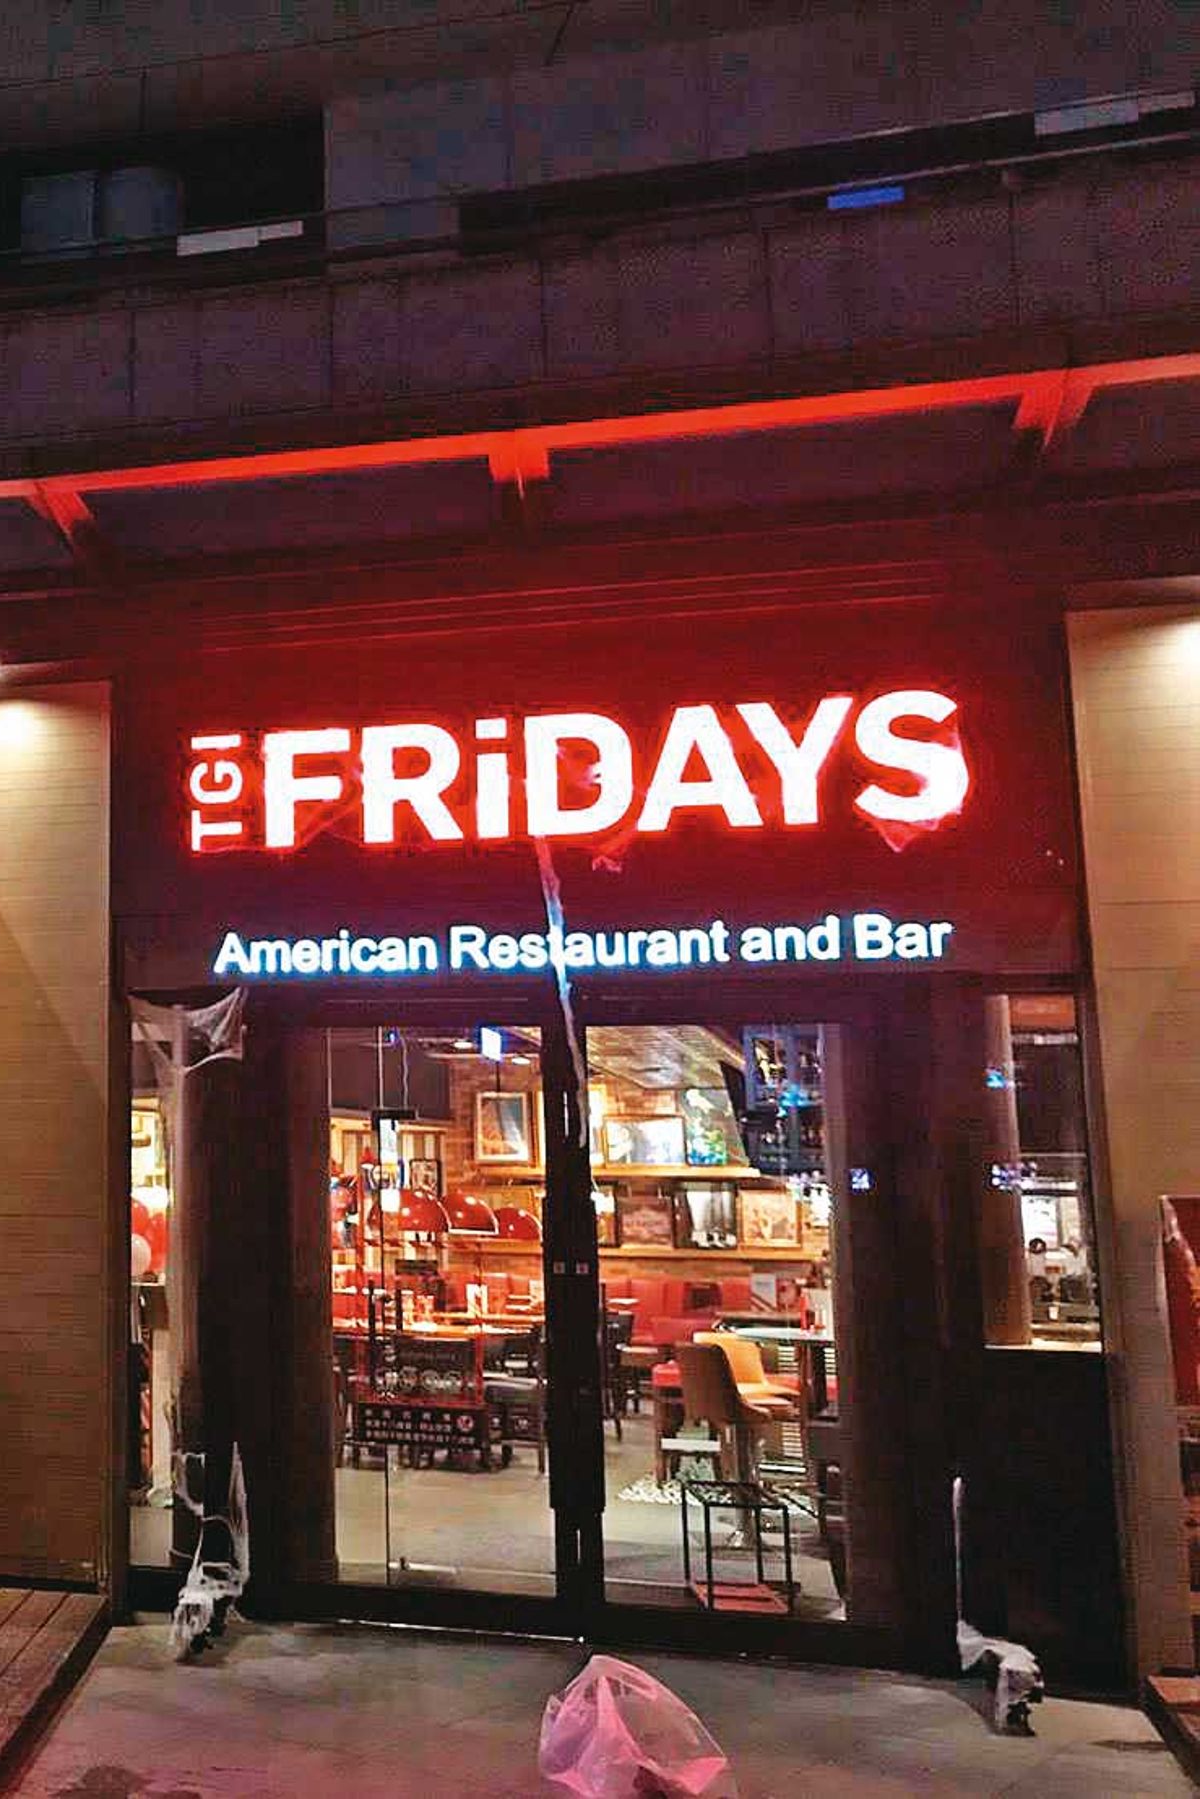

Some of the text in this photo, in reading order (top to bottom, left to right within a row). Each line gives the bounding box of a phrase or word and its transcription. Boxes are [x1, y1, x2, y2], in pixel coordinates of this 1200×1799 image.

[189, 734, 243, 851] TGI
[214, 913, 955, 975] American Restaurant and Bar
